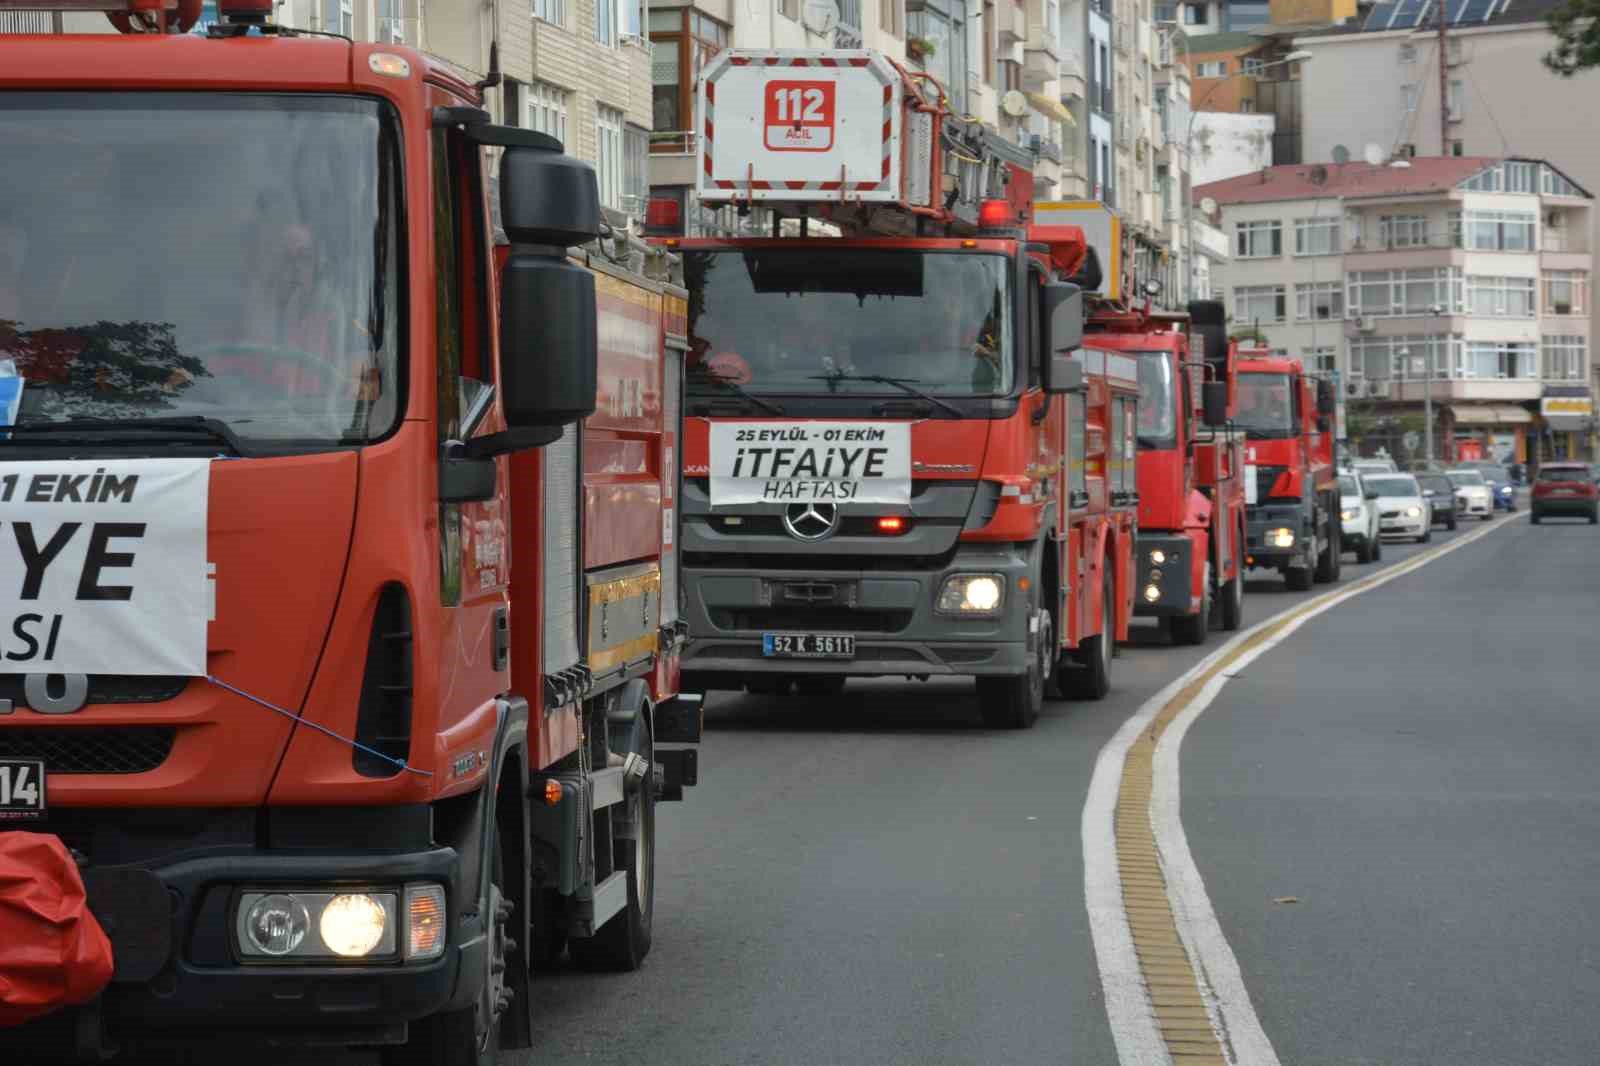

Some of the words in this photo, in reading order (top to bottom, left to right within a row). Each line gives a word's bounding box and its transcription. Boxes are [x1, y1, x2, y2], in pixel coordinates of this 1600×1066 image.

[775, 88, 824, 121] 112
[736, 430, 755, 441] 25
[758, 427, 808, 441] EYLÜL
[823, 430, 840, 441] 01
[844, 427, 885, 441] EKİM
[25, 468, 139, 503] EKİM
[763, 481, 858, 499] HAFTASI
[0, 522, 147, 600] YE
[0, 613, 63, 661] SI
[774, 637, 792, 652] 52
[797, 637, 806, 652] K
[815, 637, 850, 653] 5611
[0, 673, 88, 714] O
[0, 767, 38, 805] 14
